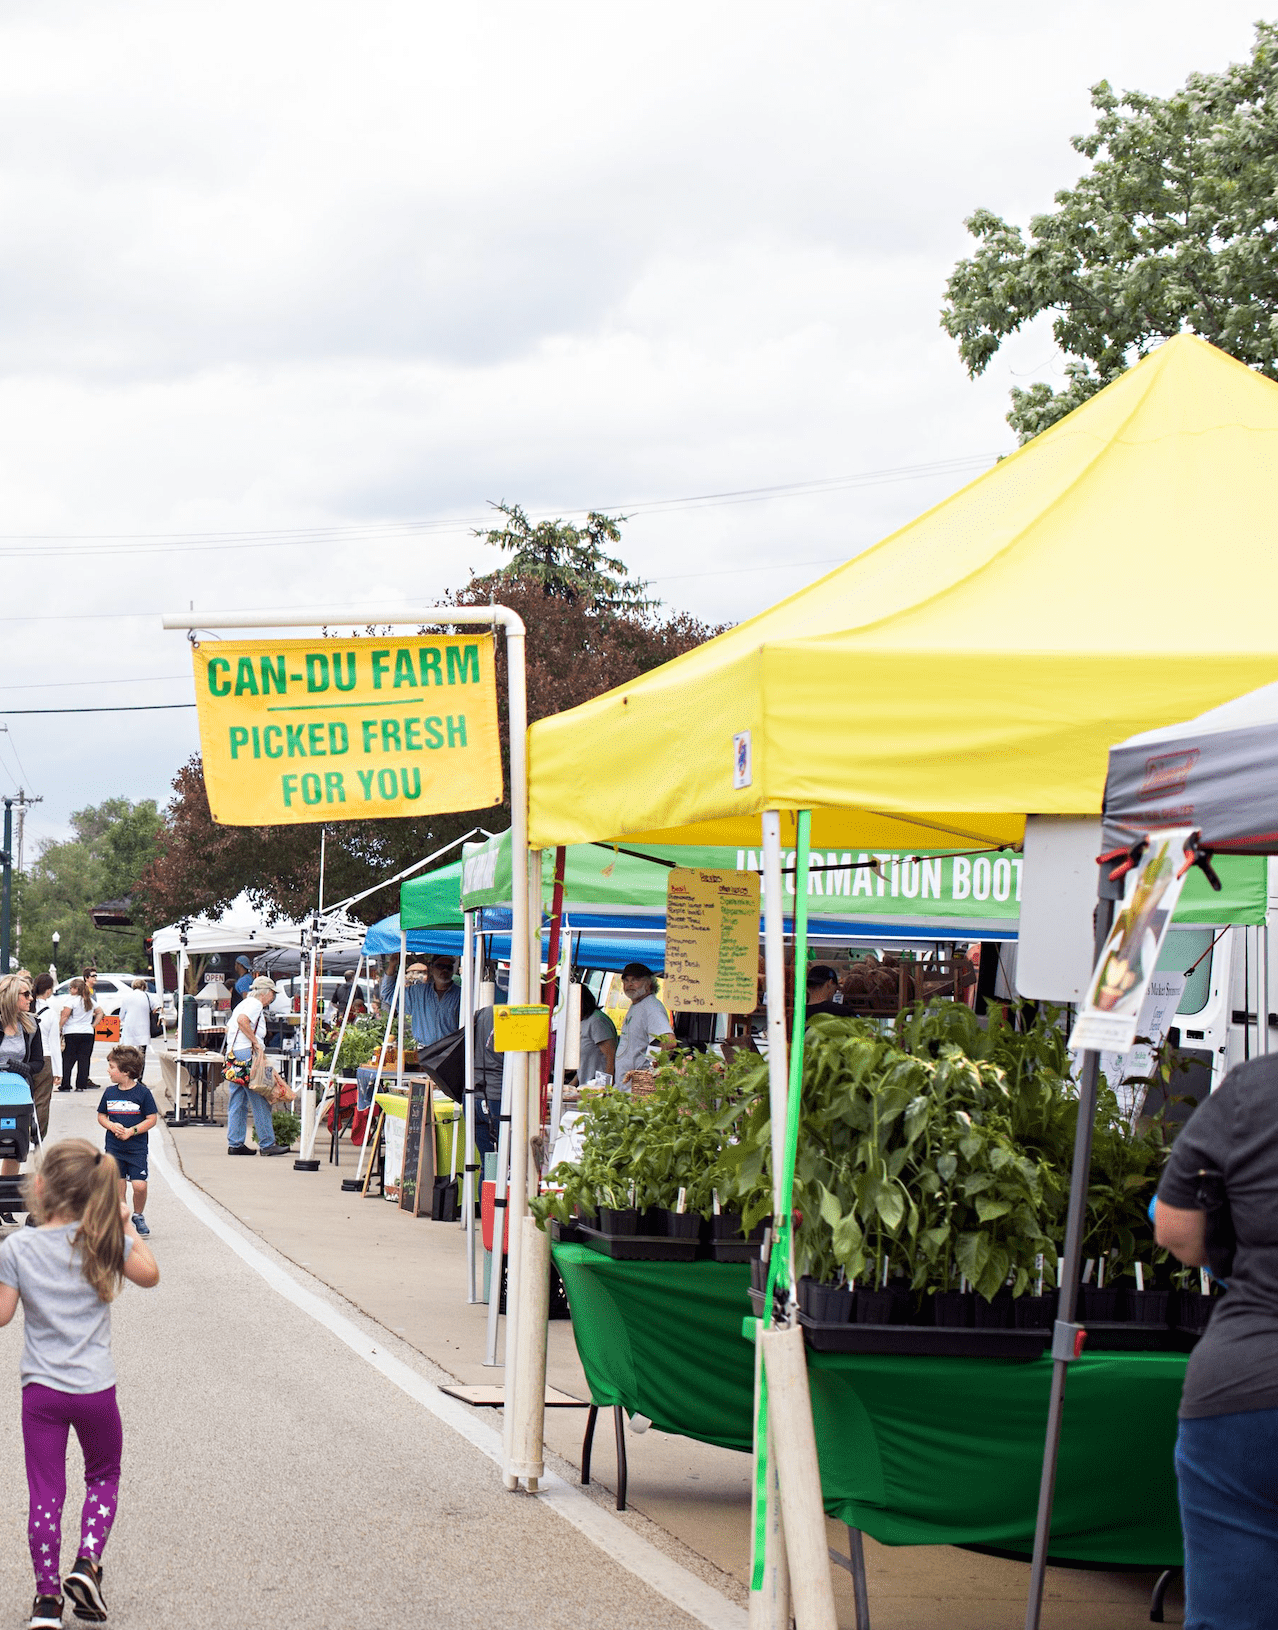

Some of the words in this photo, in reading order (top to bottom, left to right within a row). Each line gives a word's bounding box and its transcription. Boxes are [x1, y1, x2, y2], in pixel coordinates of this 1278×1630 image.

[208, 653, 358, 698] CAN-DU
[372, 645, 481, 691] FARM
[229, 722, 350, 761] PICKED
[362, 714, 468, 754] FRESH
[282, 772, 346, 808] FOR
[357, 767, 422, 803] YOU
[952, 856, 1023, 902] BOOT
[205, 974, 224, 982] OPEN
[673, 995, 682, 1007] 3
